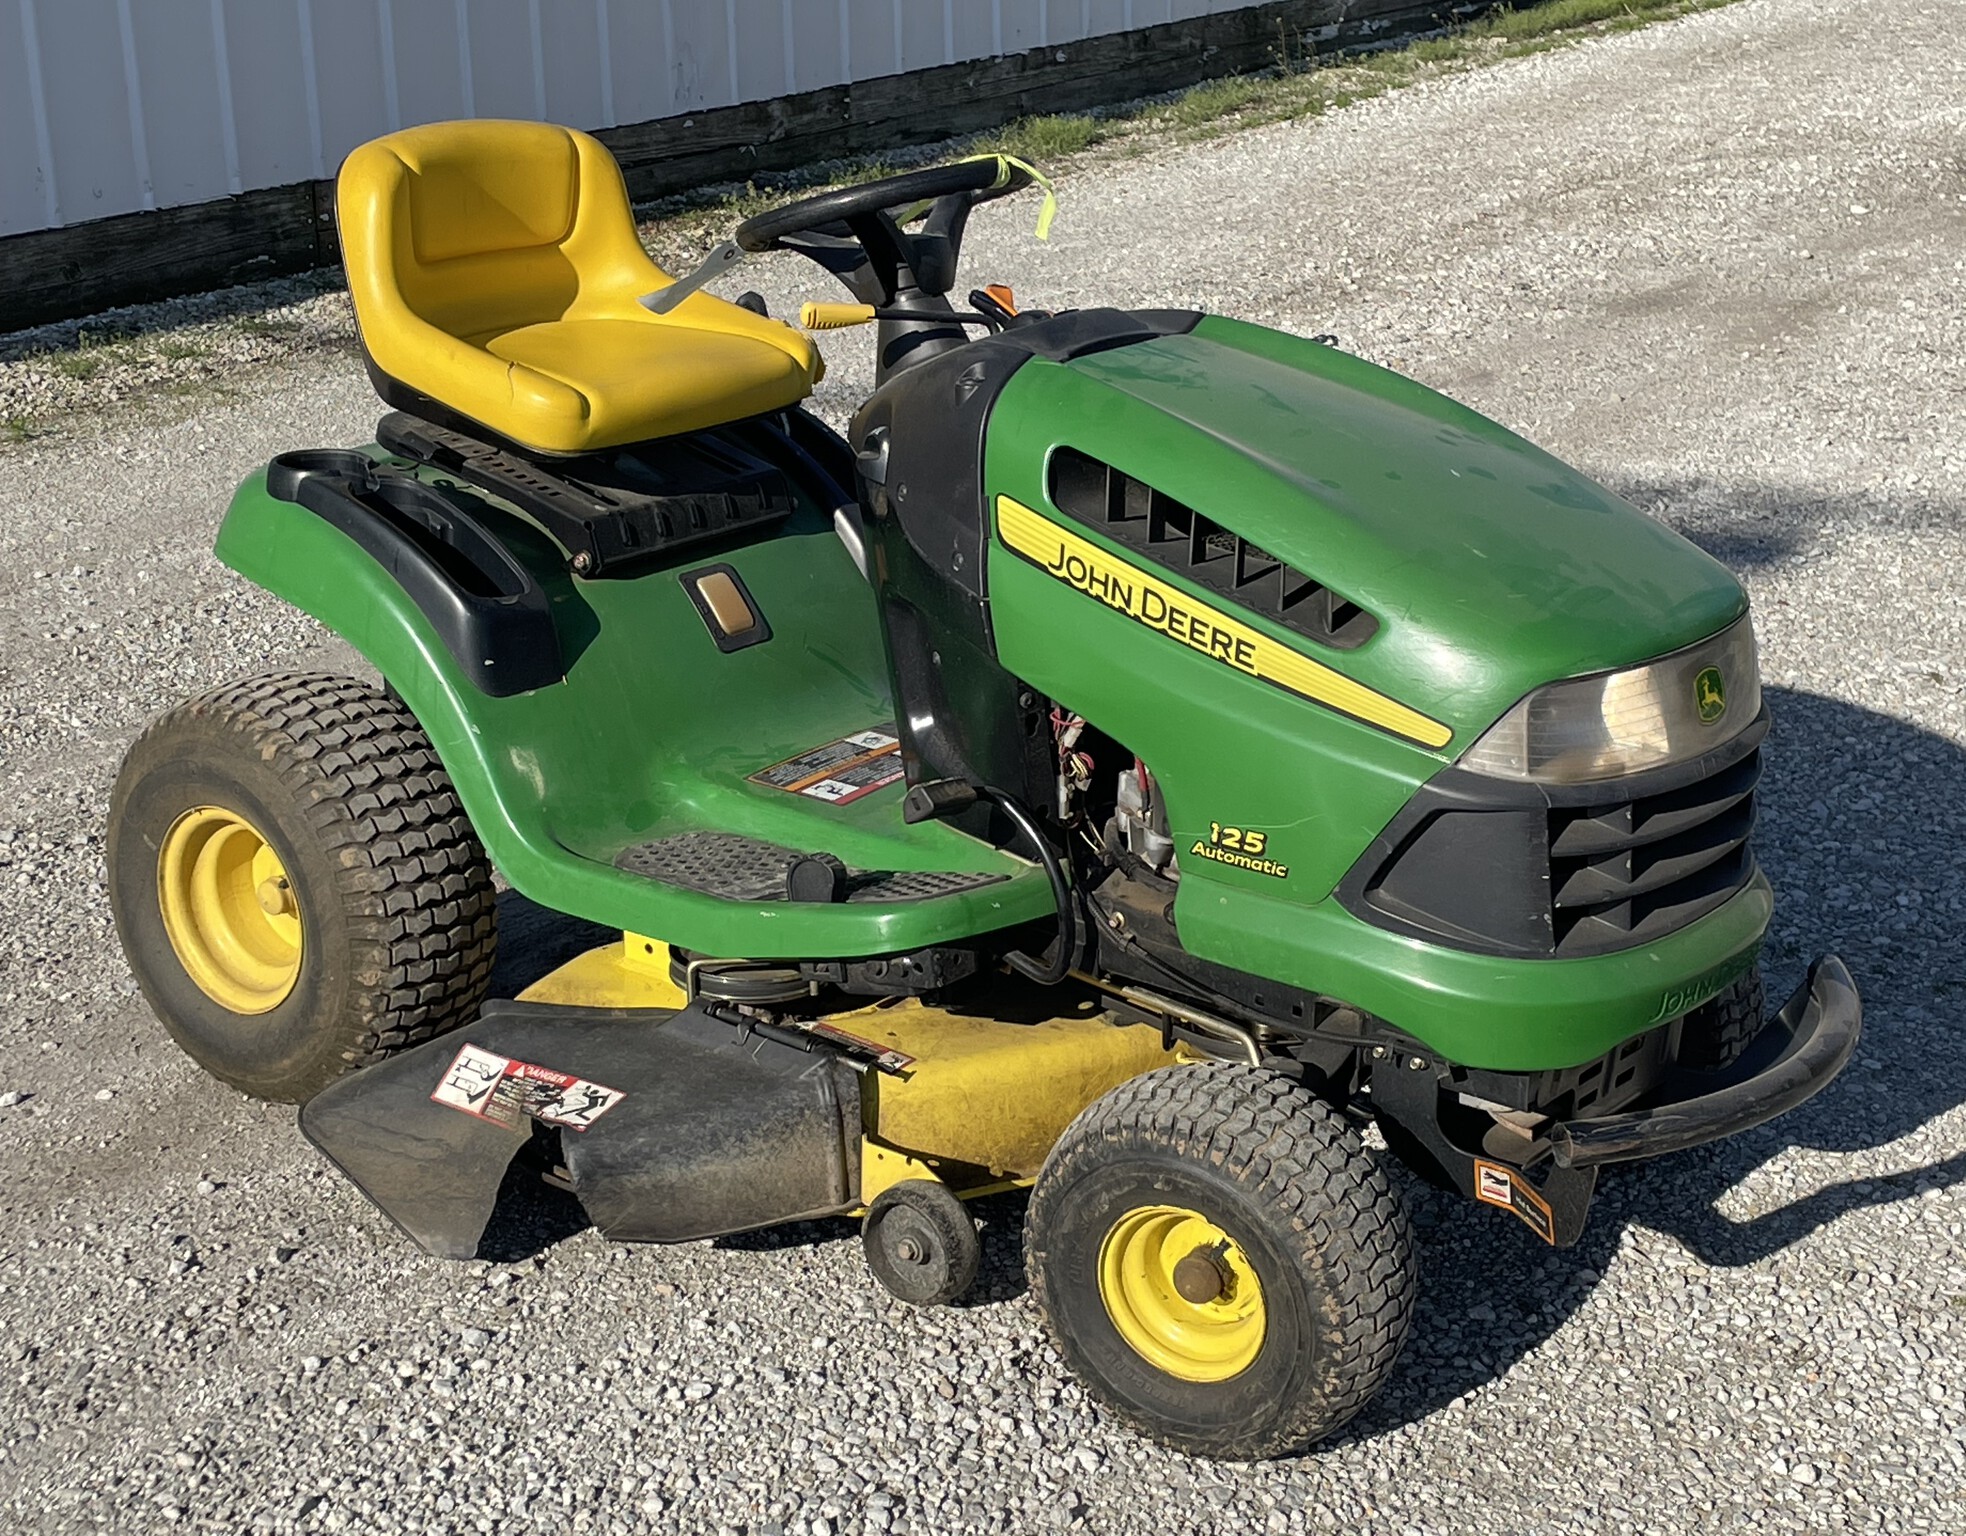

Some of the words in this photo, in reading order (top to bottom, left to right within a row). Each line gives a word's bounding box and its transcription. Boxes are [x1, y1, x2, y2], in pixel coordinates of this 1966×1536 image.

[1047, 543, 1133, 611] JOHN
[1141, 588, 1257, 670] DEERE
[1210, 821, 1266, 855] 125
[1191, 841, 1287, 877] Automatic
[1649, 977, 1714, 1023] JOHN
